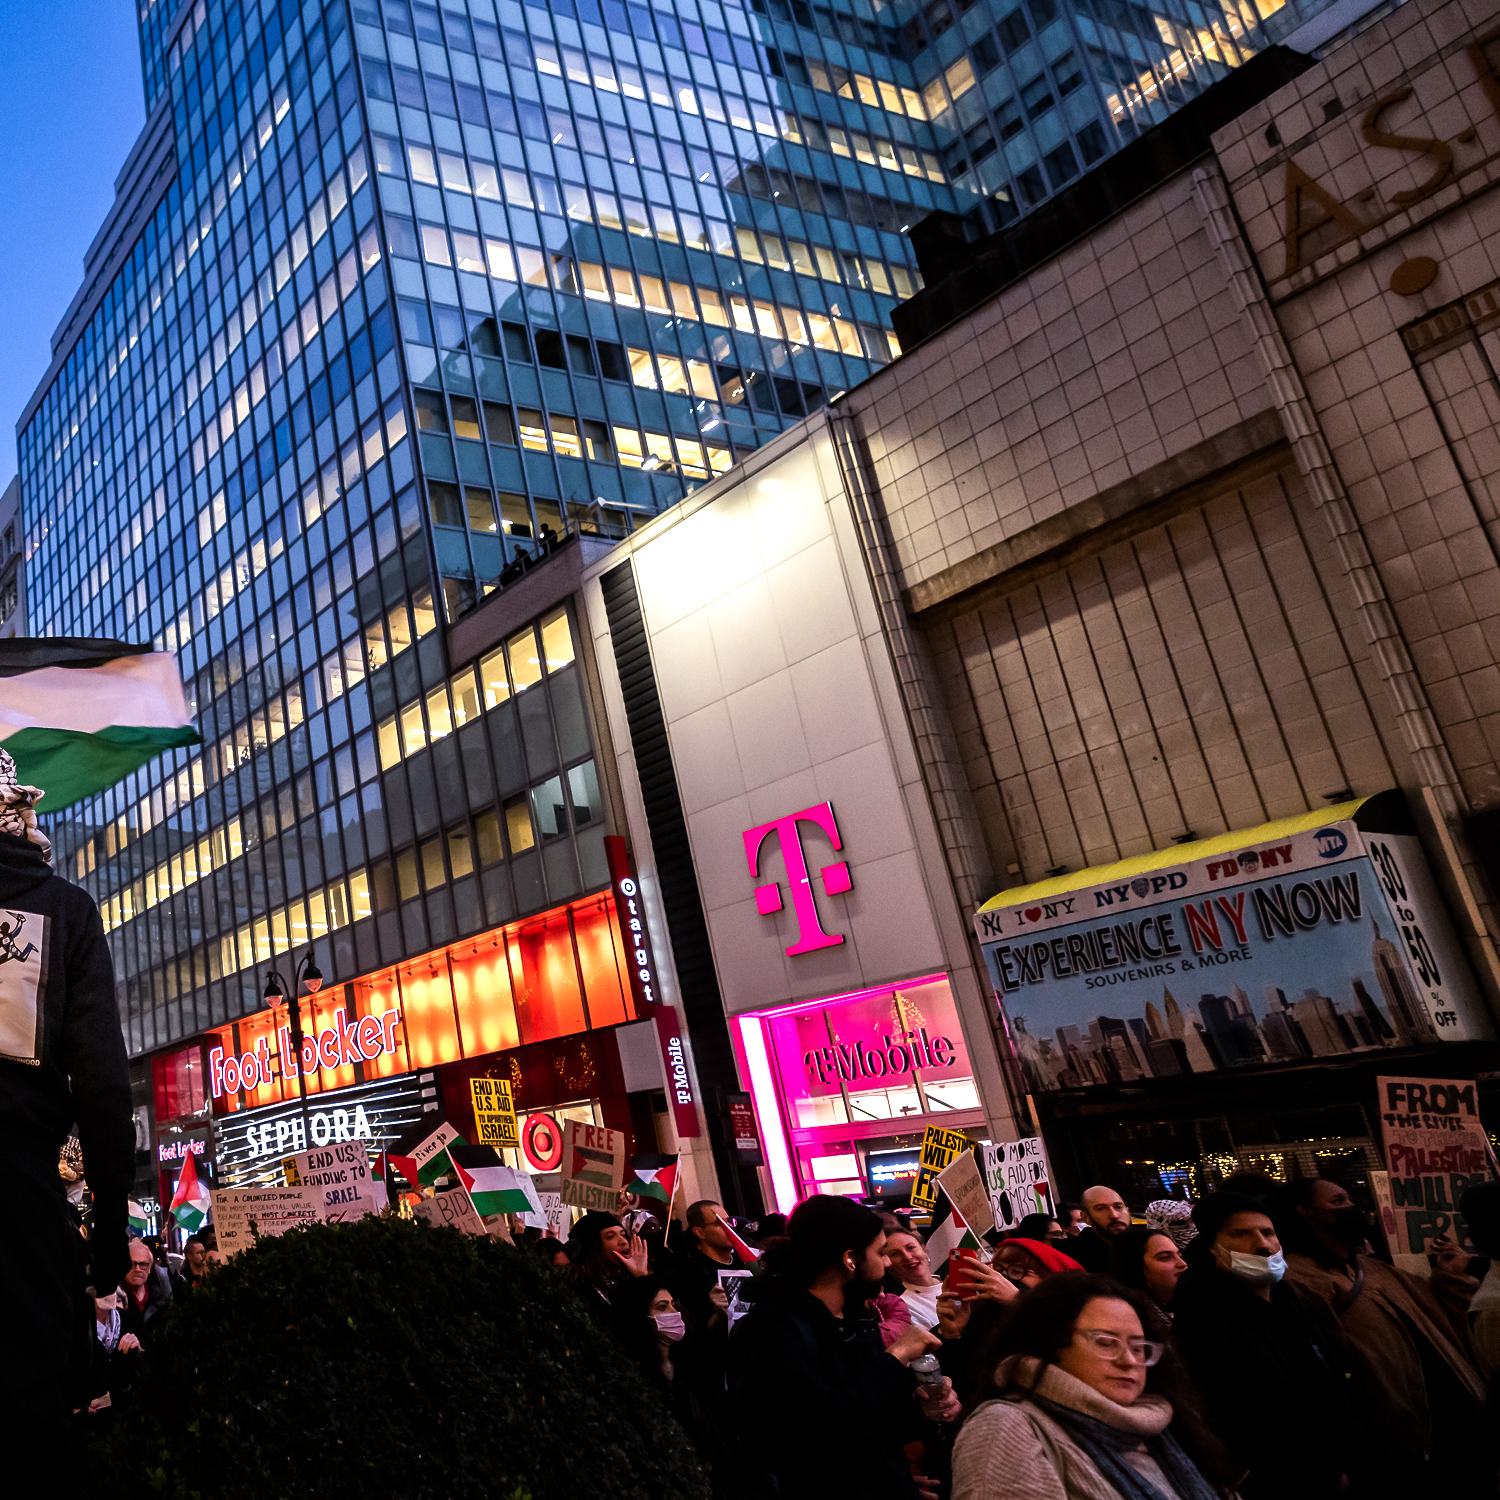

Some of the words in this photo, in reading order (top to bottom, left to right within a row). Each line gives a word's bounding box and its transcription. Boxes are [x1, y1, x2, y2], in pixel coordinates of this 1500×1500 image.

[1370, 841, 1408, 902] 30
[1397, 905, 1415, 922] to
[996, 913, 1182, 991] EXPERIENCE
[1184, 892, 1249, 953] NY
[1254, 871, 1362, 938] NOW
[628, 899, 653, 1001] target
[1401, 925, 1442, 988] 50
[1085, 962, 1176, 990] SOUVENIRS
[1182, 958, 1195, 971] &
[1199, 947, 1253, 968] MORE
[1431, 992, 1445, 1007] %
[1434, 1011, 1458, 1028] OFF
[209, 1036, 274, 1099] Foot
[278, 1008, 400, 1080] Locker
[473, 1080, 493, 1096] END
[493, 1081, 510, 1097] ALL
[1386, 1083, 1477, 1116] FROM
[475, 1096, 496, 1112] U.S.
[497, 1096, 512, 1112] AID
[247, 1104, 372, 1158] SEPHORA
[478, 1114, 486, 1124] TO
[480, 1123, 516, 1140] ISRAEL!
[1383, 1113, 1422, 1130] THE
[1421, 1115, 1466, 1131] RIVER
[572, 1122, 615, 1151] FREE
[925, 1126, 977, 1153] PALESTINE
[308, 1151, 334, 1169] END
[988, 1145, 1006, 1167] NO
[1009, 1138, 1040, 1162] MORE
[1388, 1143, 1487, 1177] PALESTINE
[303, 1170, 348, 1187] FUNDING
[352, 1165, 366, 1181] TO
[1008, 1161, 1027, 1185] AID
[1029, 1159, 1048, 1182] FOR
[324, 1185, 363, 1207] SRAEL
[563, 1178, 620, 1212] PALESTIN
[992, 1184, 1038, 1230] BOMBS
[1391, 1176, 1453, 1212] WILL
[1404, 1211, 1476, 1255] FRE
